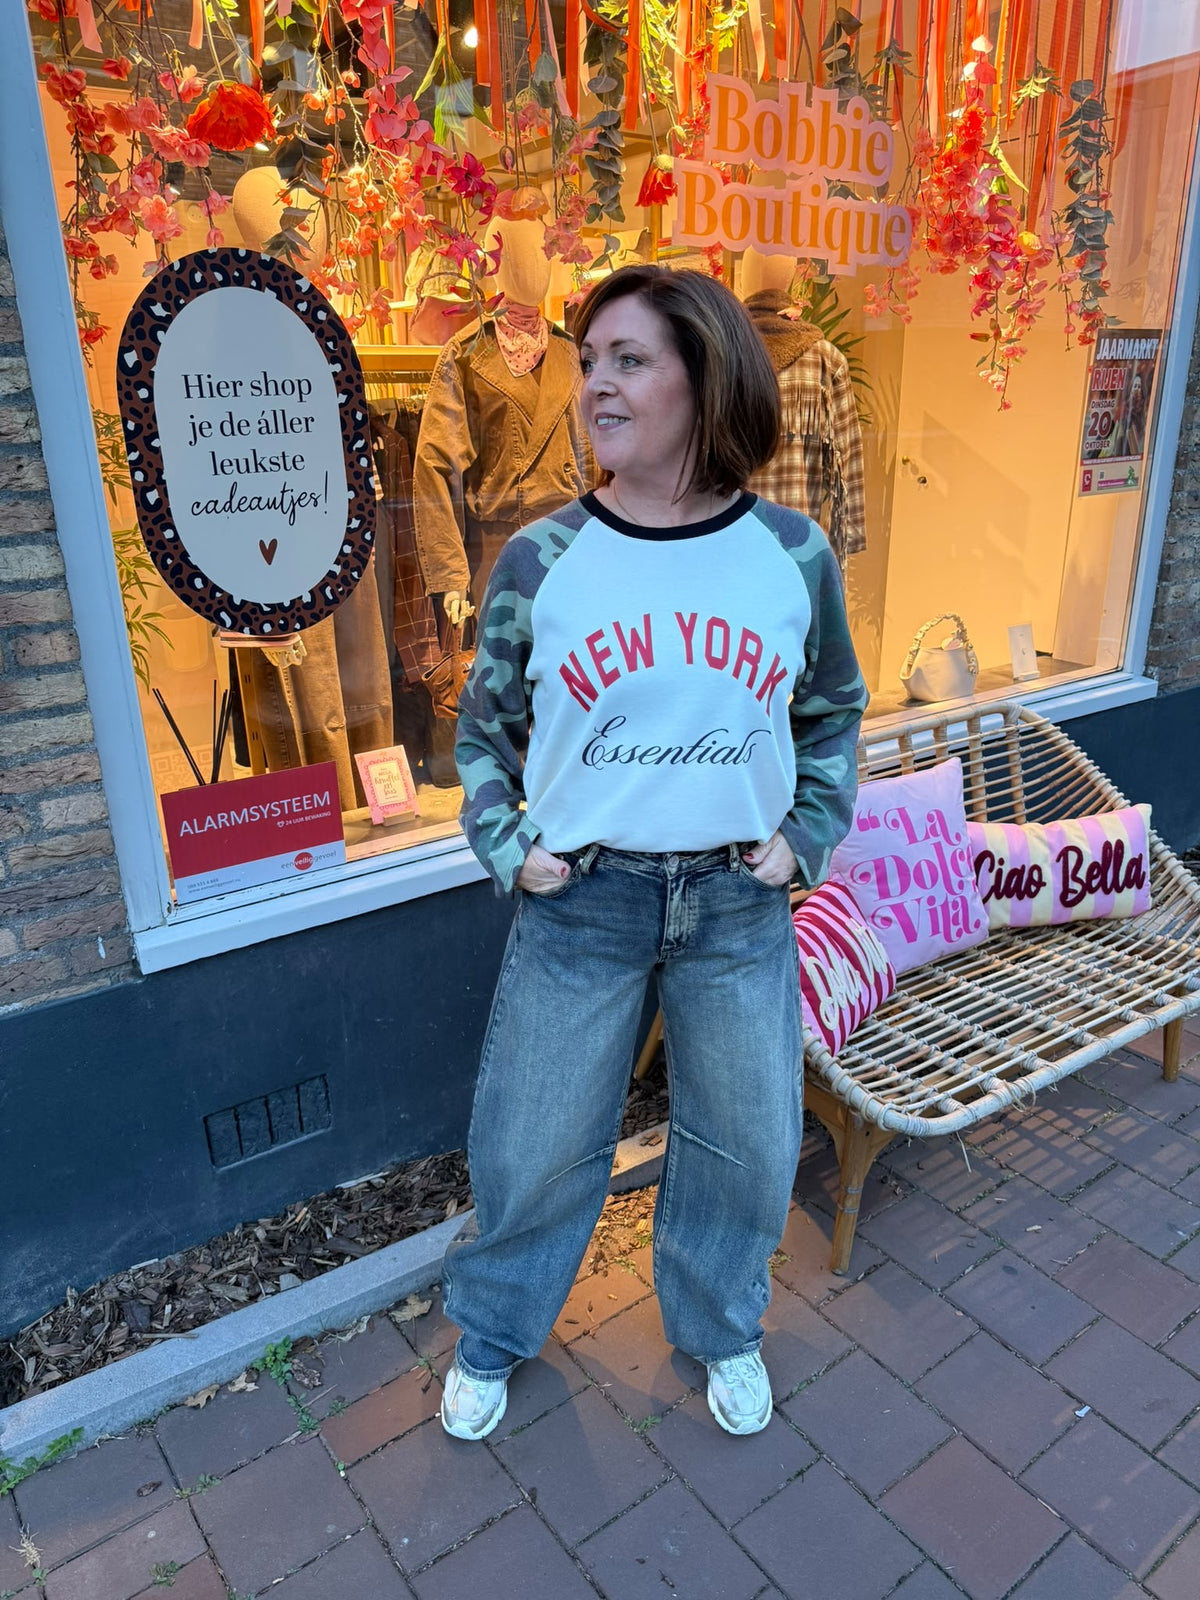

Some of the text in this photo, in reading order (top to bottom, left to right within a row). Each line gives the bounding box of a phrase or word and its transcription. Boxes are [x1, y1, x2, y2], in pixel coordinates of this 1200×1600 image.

[712, 84, 889, 176] Bobbie
[681, 170, 906, 266] Boutique
[1096, 337, 1160, 360] JAARMARKT
[182, 371, 312, 402] Hier shop
[1091, 367, 1127, 391] RIJEN
[1087, 410, 1112, 437] 20
[1091, 400, 1115, 409] DINSDAG
[188, 409, 315, 447] je de áller
[1084, 440, 1111, 450] OKTOBER
[210, 448, 305, 476] leukste
[191, 470, 329, 526] cadeautjes!
[558, 611, 788, 718] NEW YORK
[581, 715, 772, 771] Essentials
[179, 791, 331, 837] ALARMSYSTEEM
[974, 838, 1146, 908] Ciao Bella
